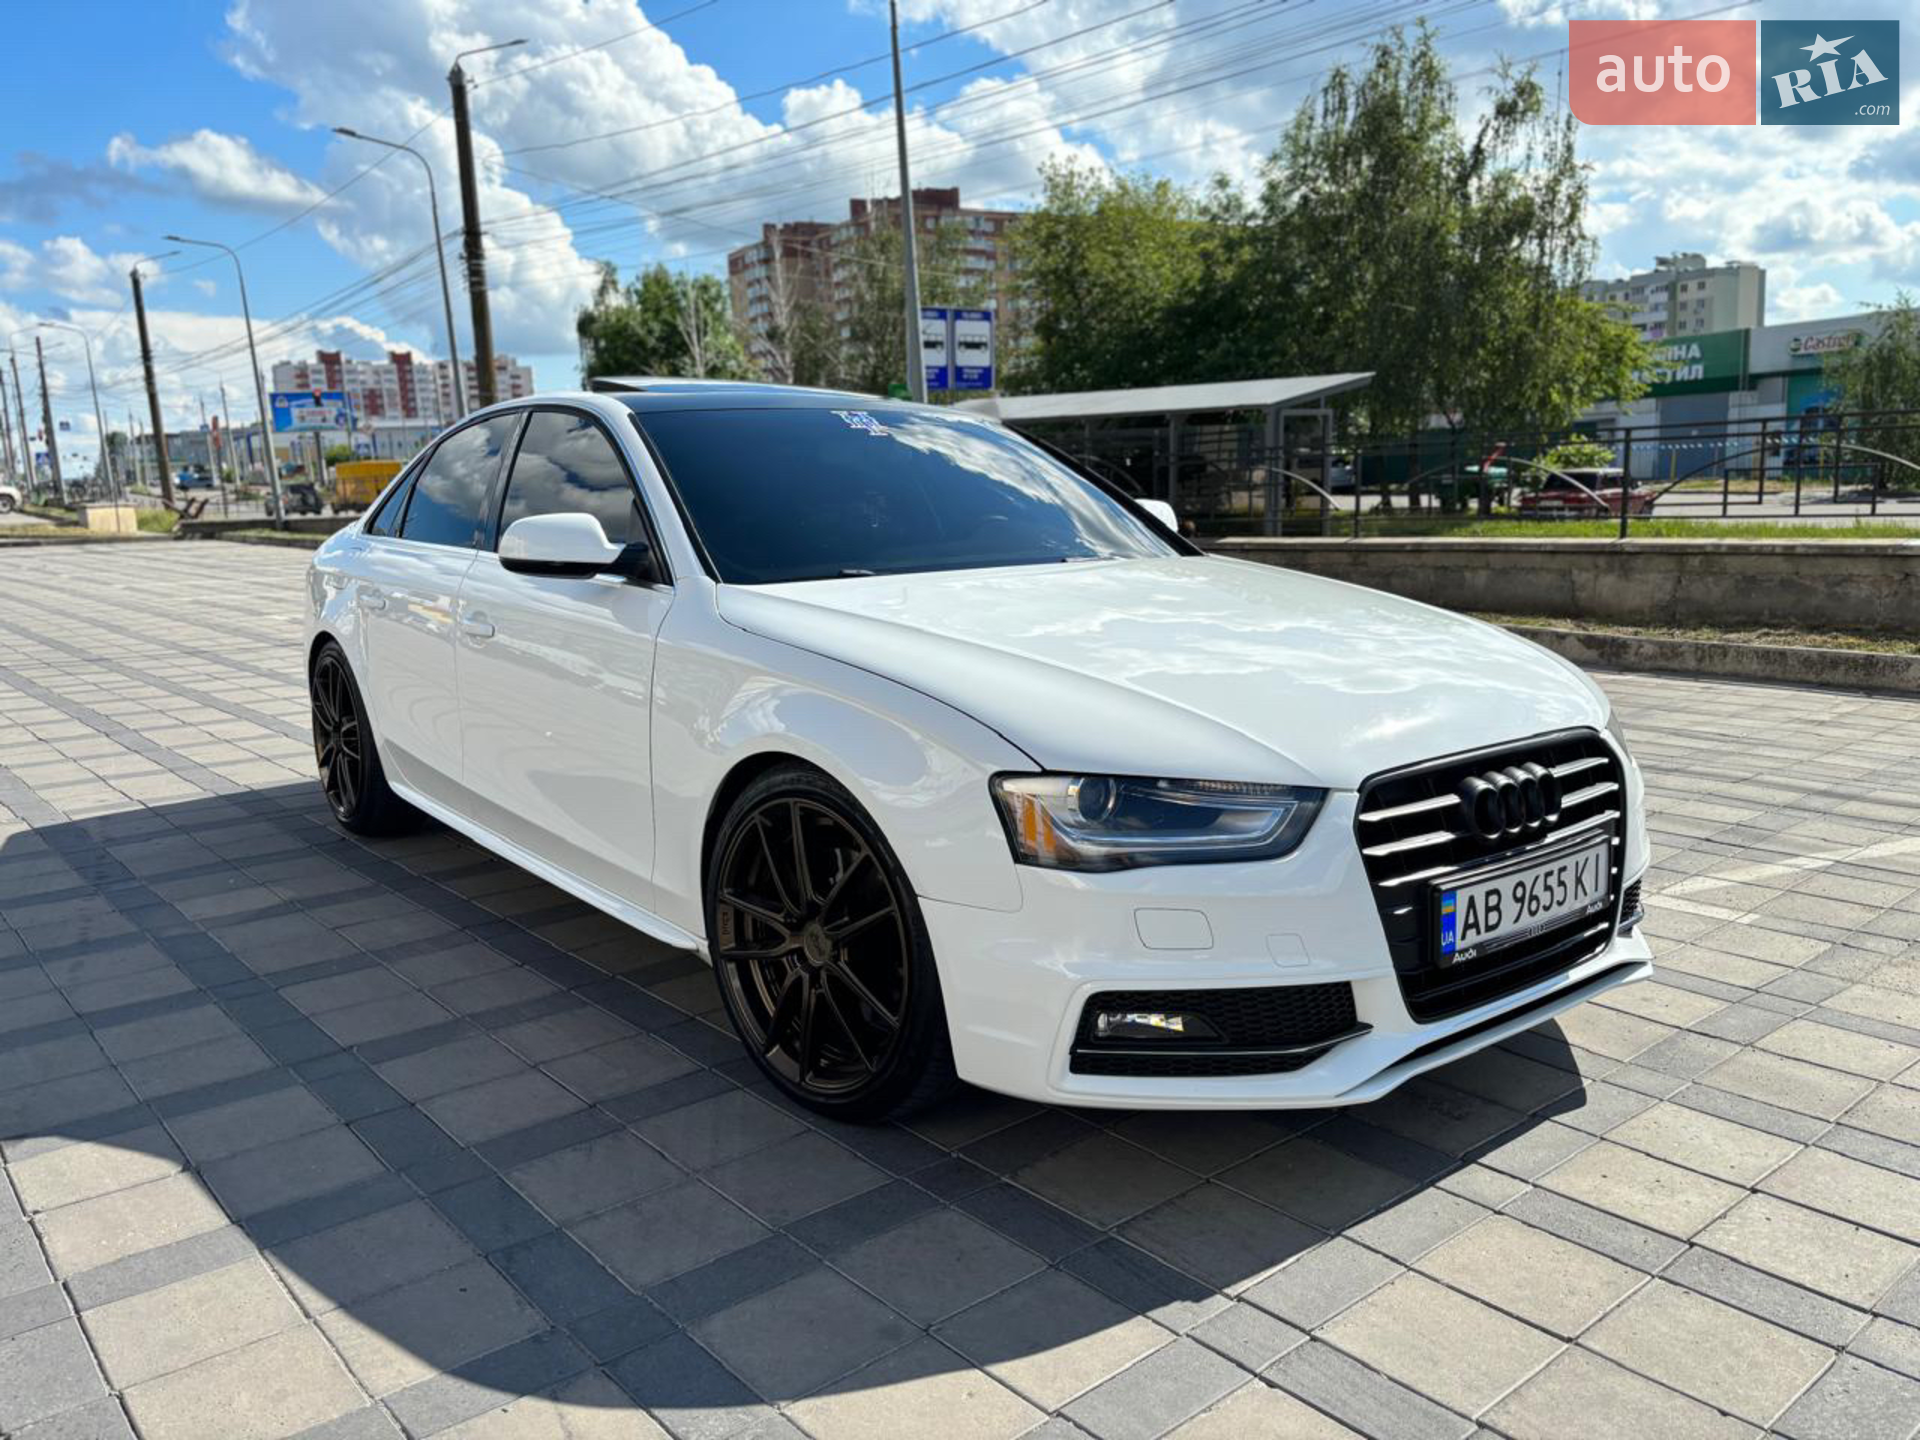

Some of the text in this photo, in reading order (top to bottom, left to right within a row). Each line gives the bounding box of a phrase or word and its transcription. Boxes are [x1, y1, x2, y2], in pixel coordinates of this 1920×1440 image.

[1460, 853, 1600, 941] AB 9655 KI
[1441, 931, 1455, 946] UA
[1452, 948, 1477, 964] Audi
